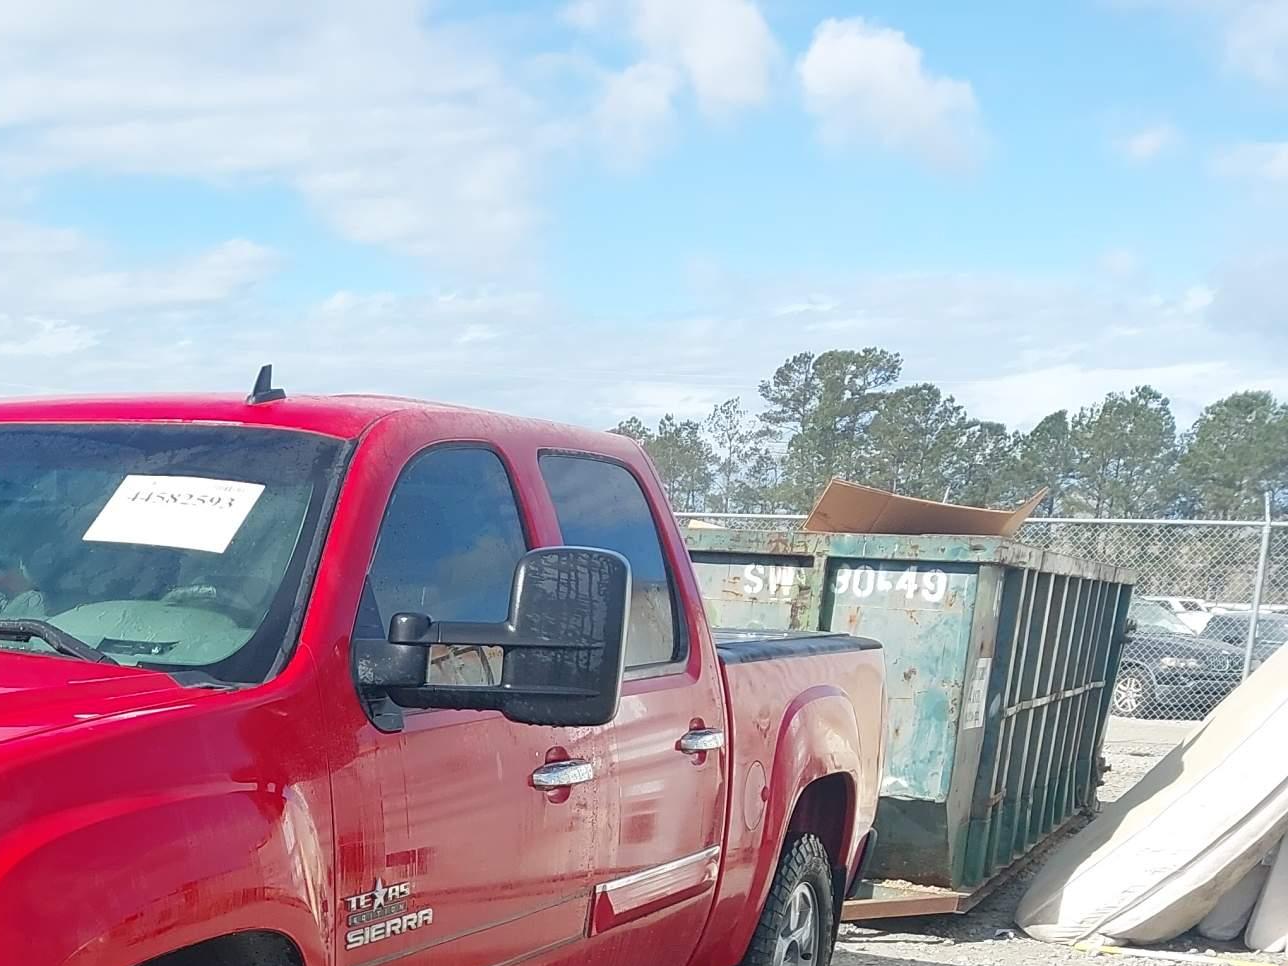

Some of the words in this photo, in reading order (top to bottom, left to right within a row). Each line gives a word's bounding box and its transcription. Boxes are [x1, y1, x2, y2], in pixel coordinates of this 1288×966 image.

[128, 491, 236, 509] 44582593
[346, 878, 411, 912] TEXAS
[346, 907, 433, 950] SIERRA
